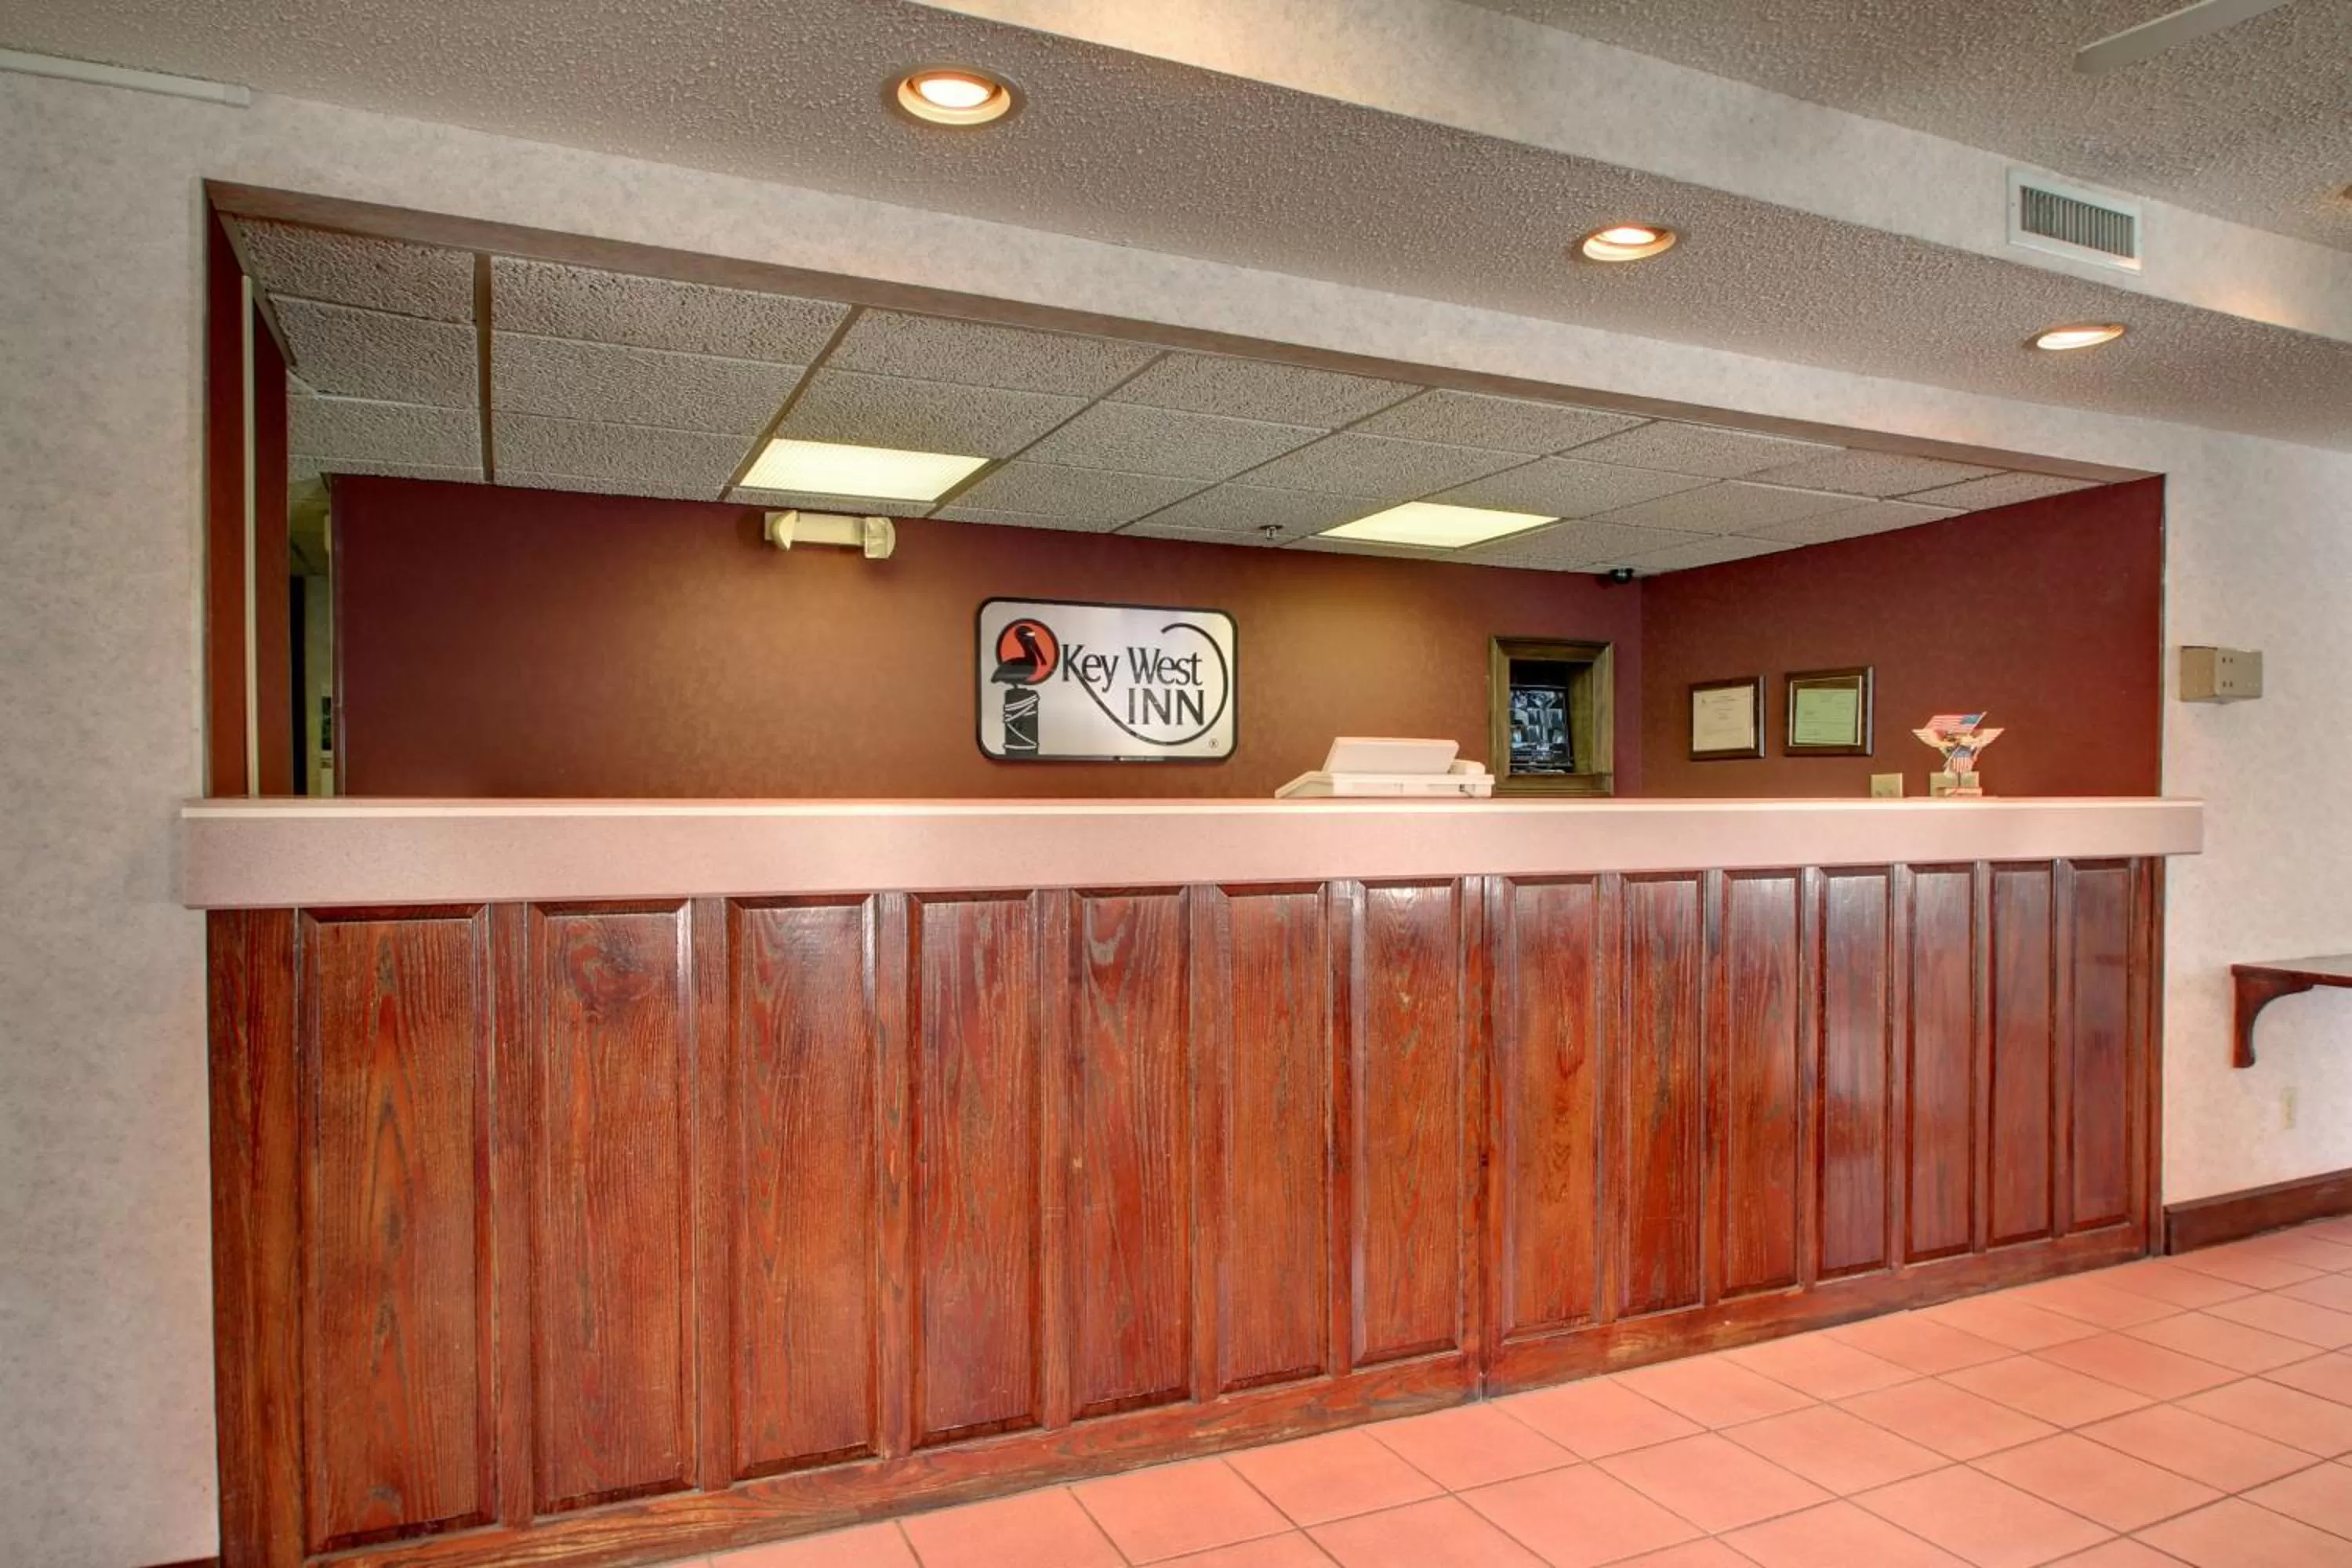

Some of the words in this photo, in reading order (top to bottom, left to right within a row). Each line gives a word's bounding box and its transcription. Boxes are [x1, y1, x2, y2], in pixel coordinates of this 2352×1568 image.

[1062, 644, 1118, 692] Key
[1127, 647, 1203, 686] West
[1128, 688, 1204, 726] INN
